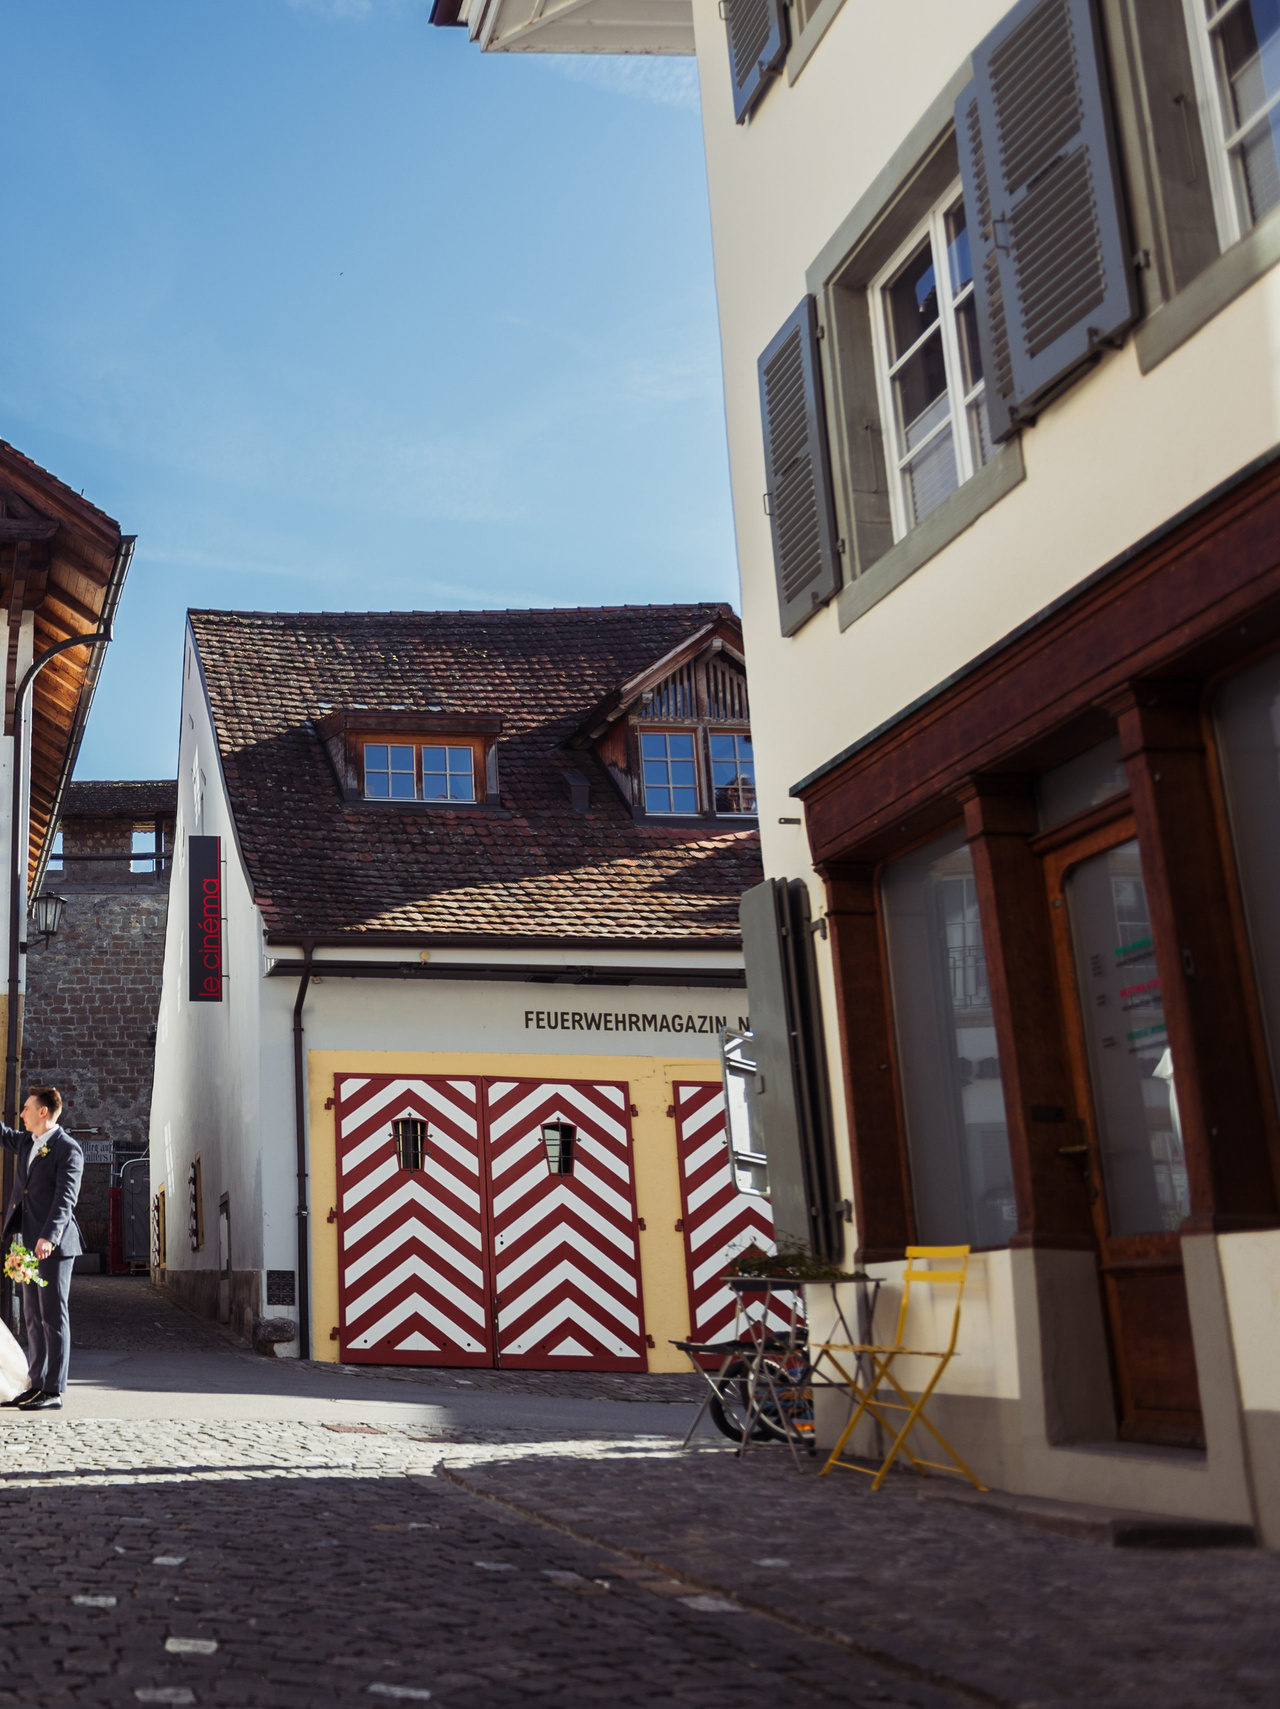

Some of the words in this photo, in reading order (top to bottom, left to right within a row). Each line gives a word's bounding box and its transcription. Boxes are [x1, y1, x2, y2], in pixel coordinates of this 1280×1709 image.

[198, 878, 220, 970] cinéma
[199, 976, 220, 997] le
[523, 1010, 727, 1034] FEUERWEHRMAGAZIN
[737, 1016, 751, 1032] N
